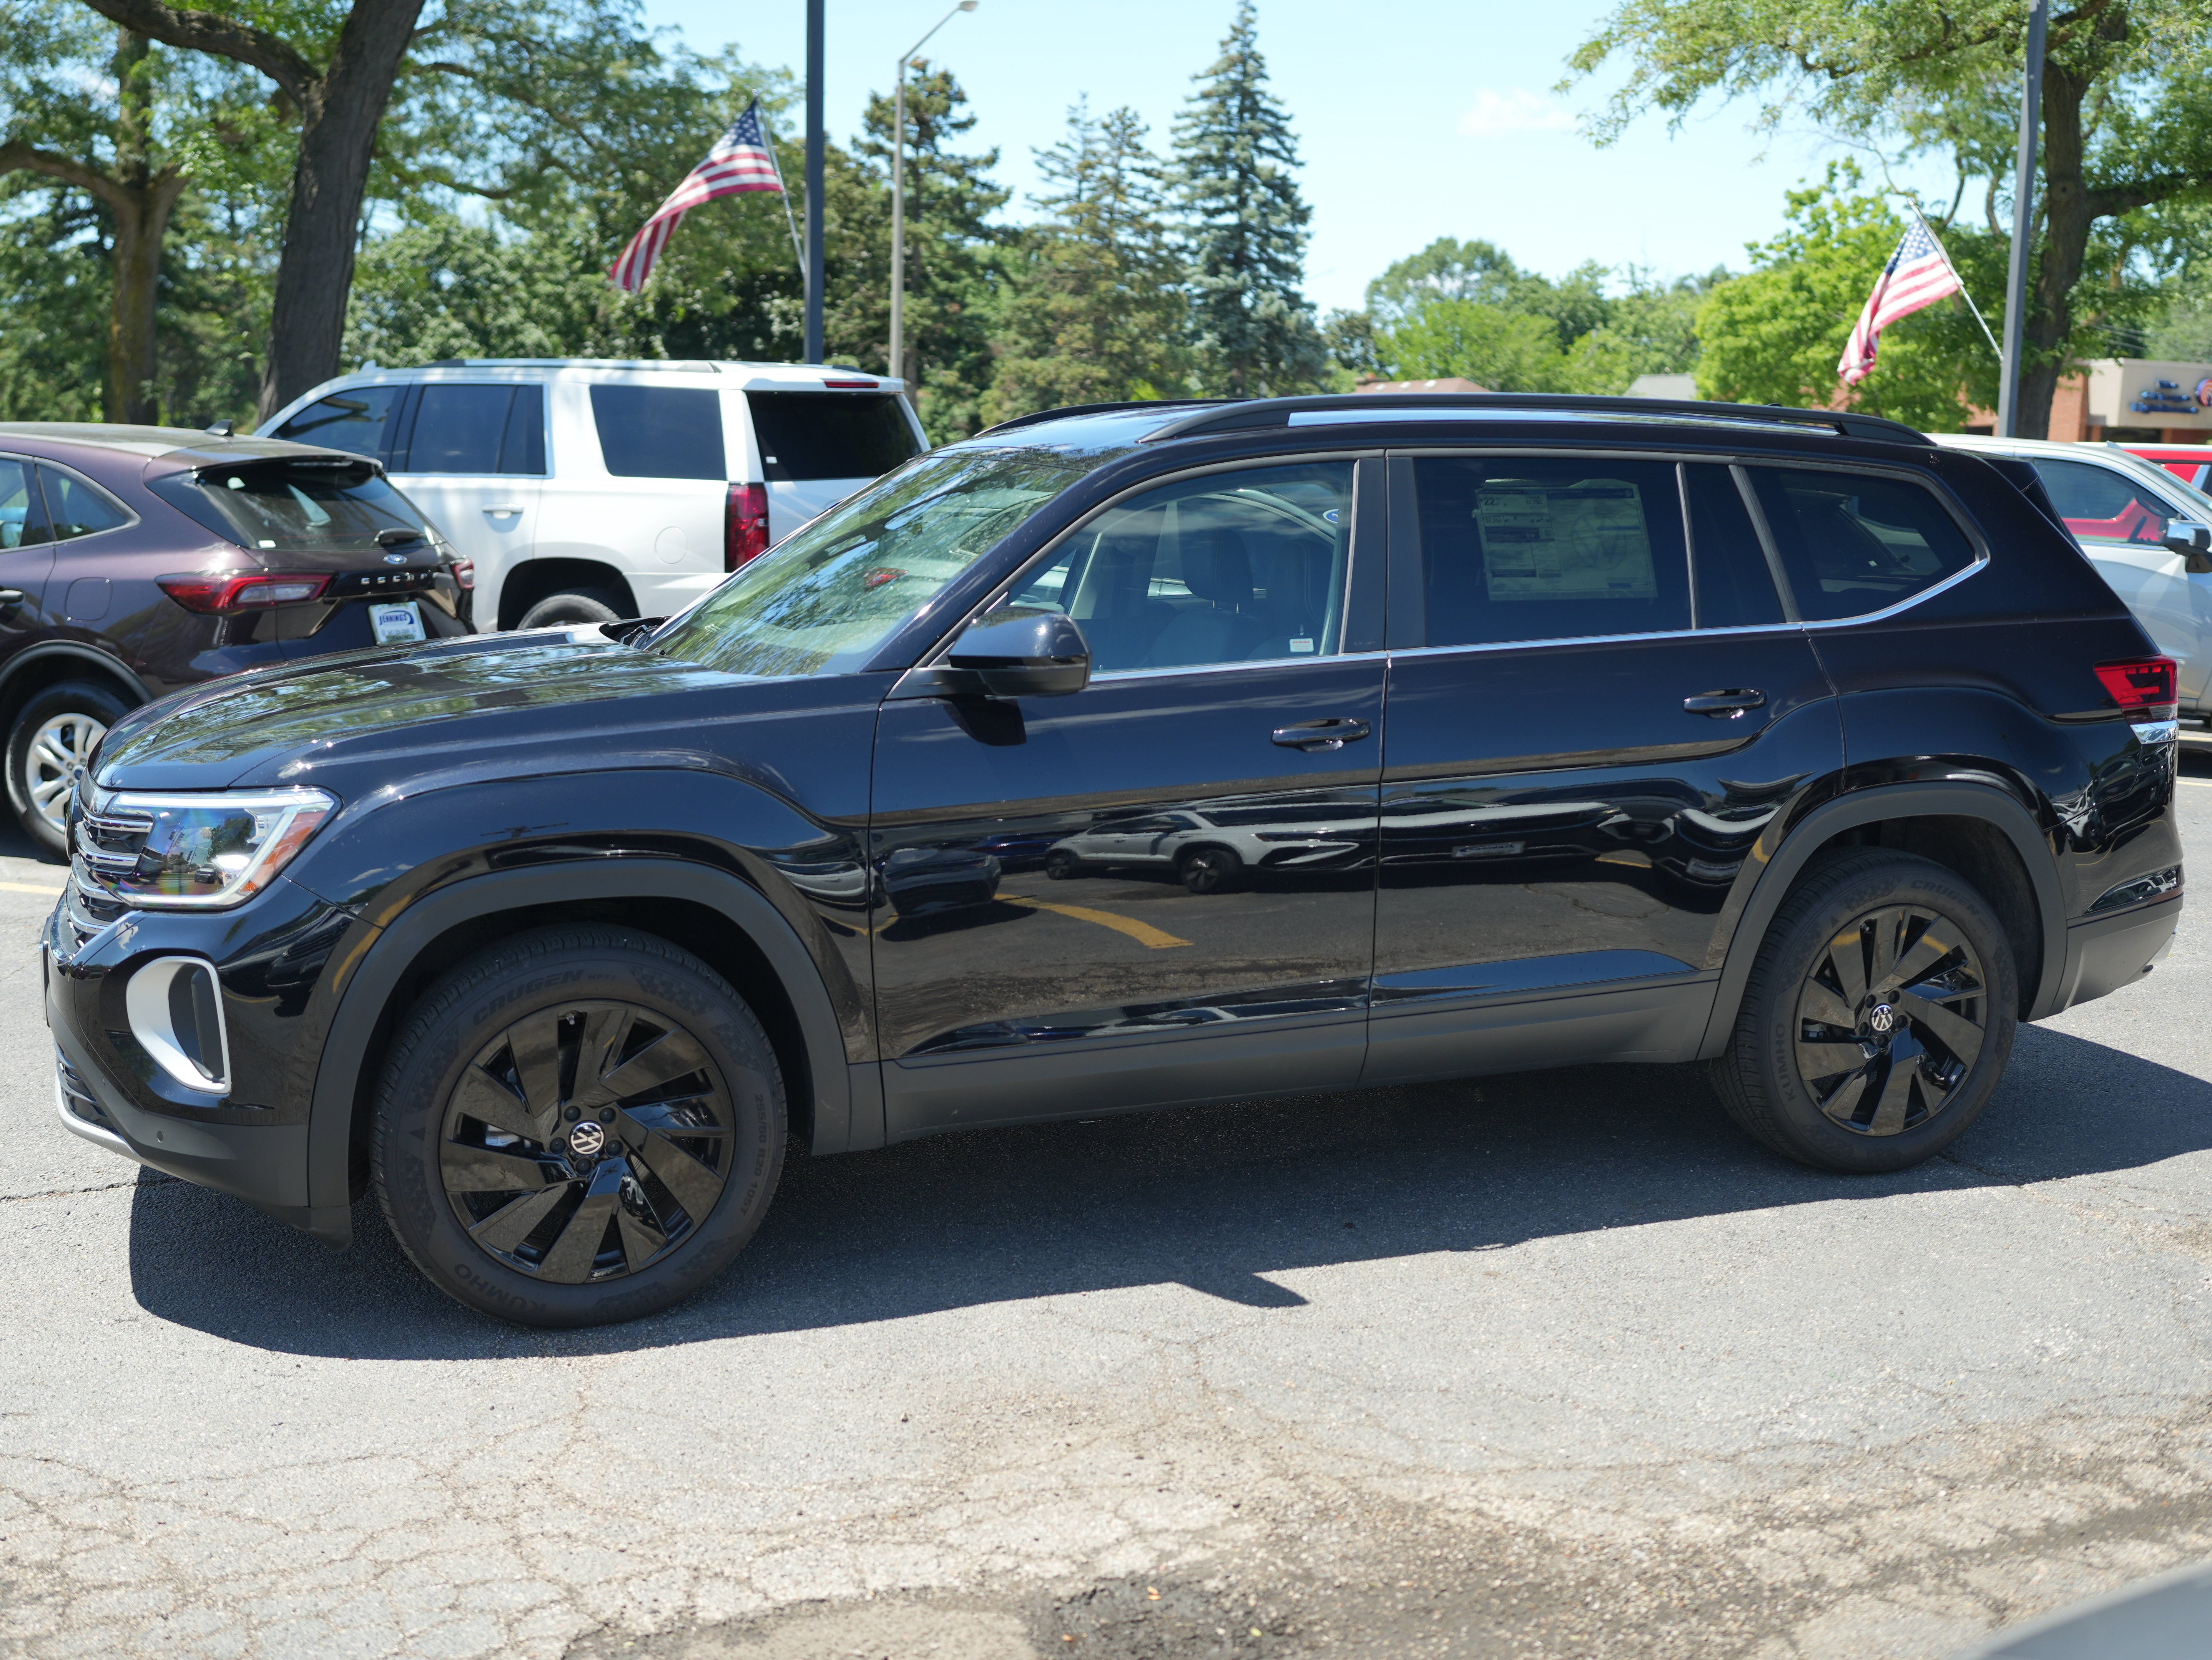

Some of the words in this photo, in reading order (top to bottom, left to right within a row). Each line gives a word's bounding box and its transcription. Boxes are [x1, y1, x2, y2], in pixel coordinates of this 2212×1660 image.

[1484, 497, 1495, 505] 22
[379, 613, 407, 625] JENNINGS
[1911, 880, 1980, 915] CRUGEN
[473, 969, 584, 1026] CRUGEN
[1776, 1022, 1797, 1102] KUMHO
[755, 1094, 767, 1143] 255/50
[754, 1148, 766, 1177] R20
[740, 1182, 758, 1216] 105T
[454, 1263, 547, 1314] KUMHO
